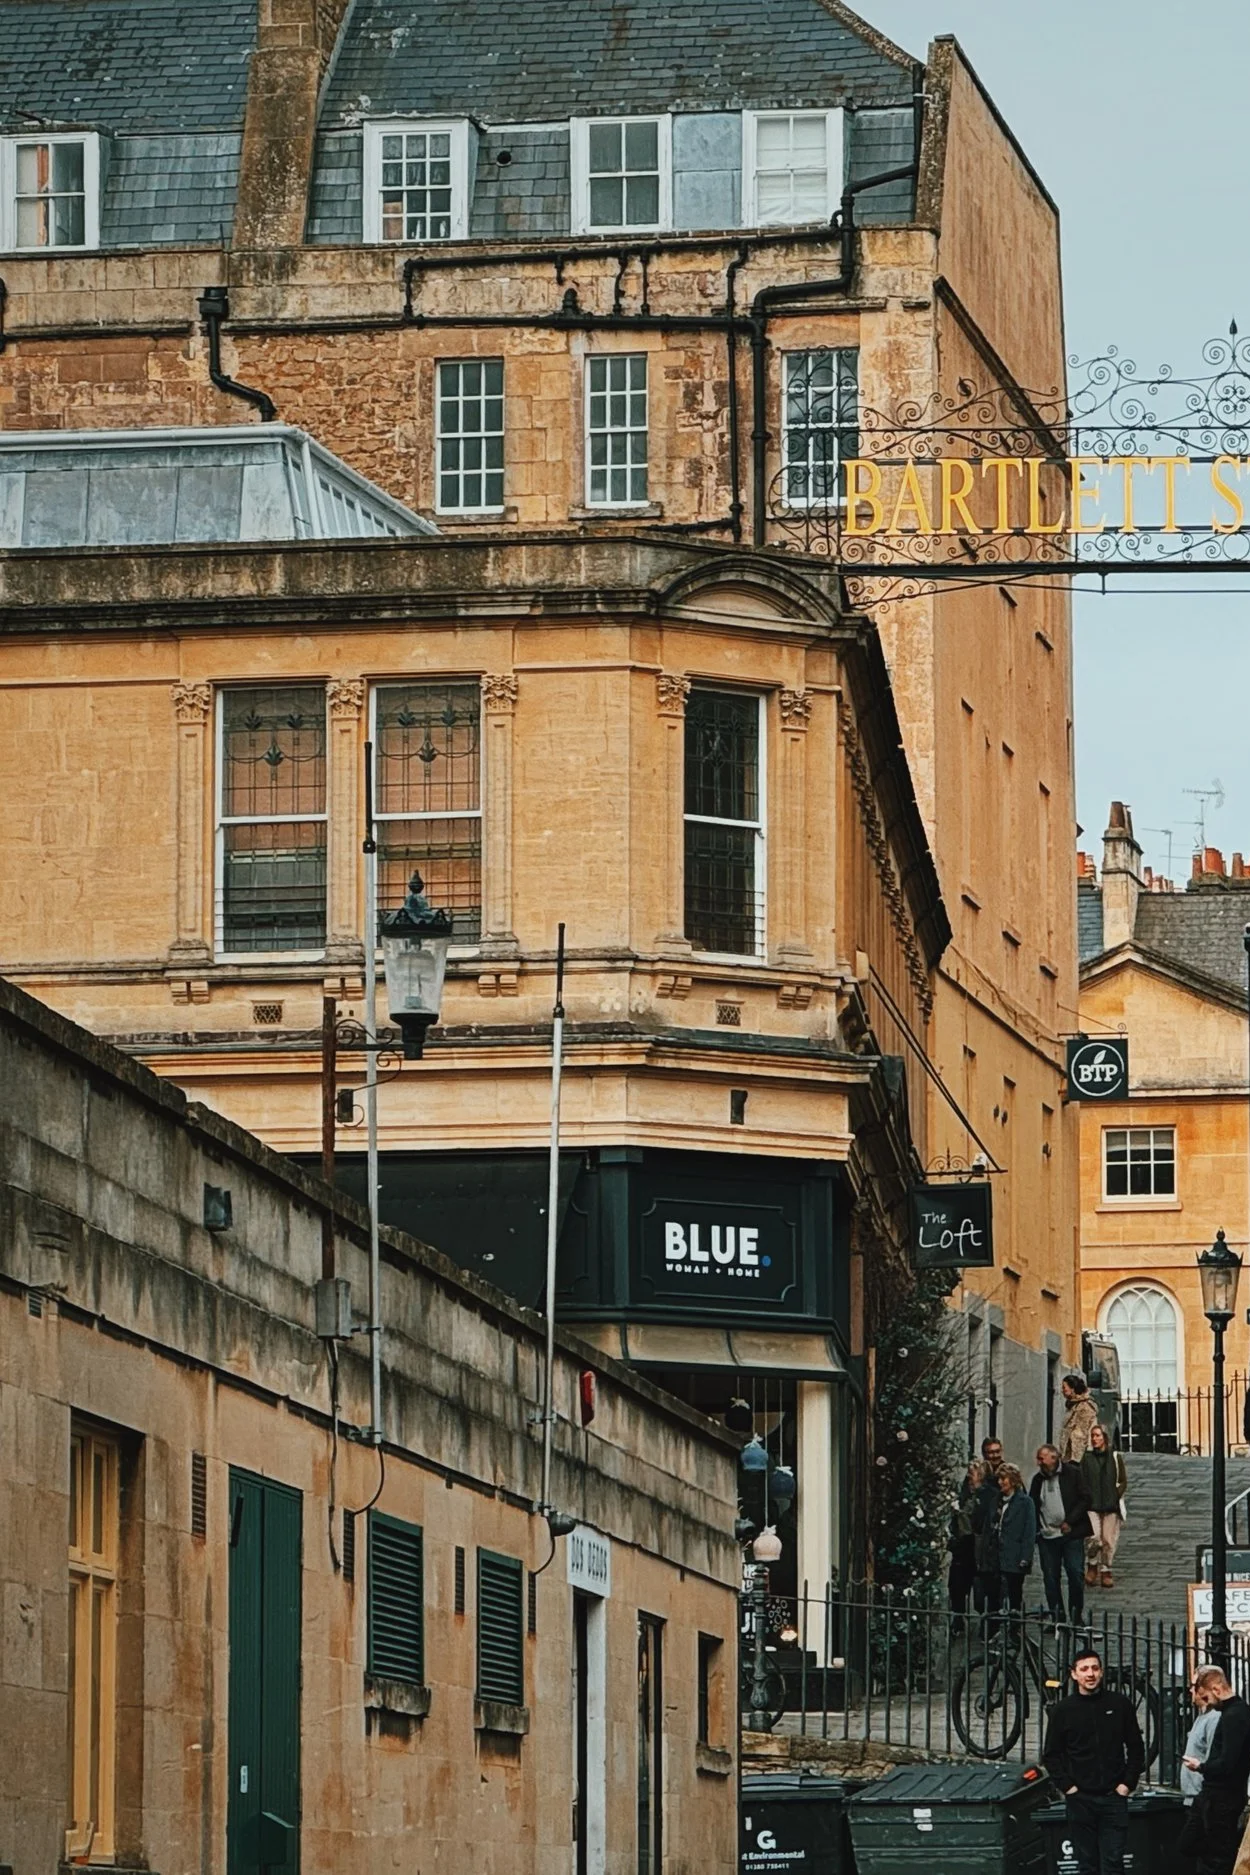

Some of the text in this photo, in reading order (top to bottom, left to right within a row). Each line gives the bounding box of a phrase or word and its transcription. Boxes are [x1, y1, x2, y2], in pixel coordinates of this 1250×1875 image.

[841, 458, 1190, 536] BARTLETT
[1078, 1064, 1118, 1083] BTP
[921, 1211, 947, 1225] The
[918, 1218, 983, 1257] Loft
[666, 1263, 709, 1274] WOMAN
[727, 1267, 760, 1278] HOME
